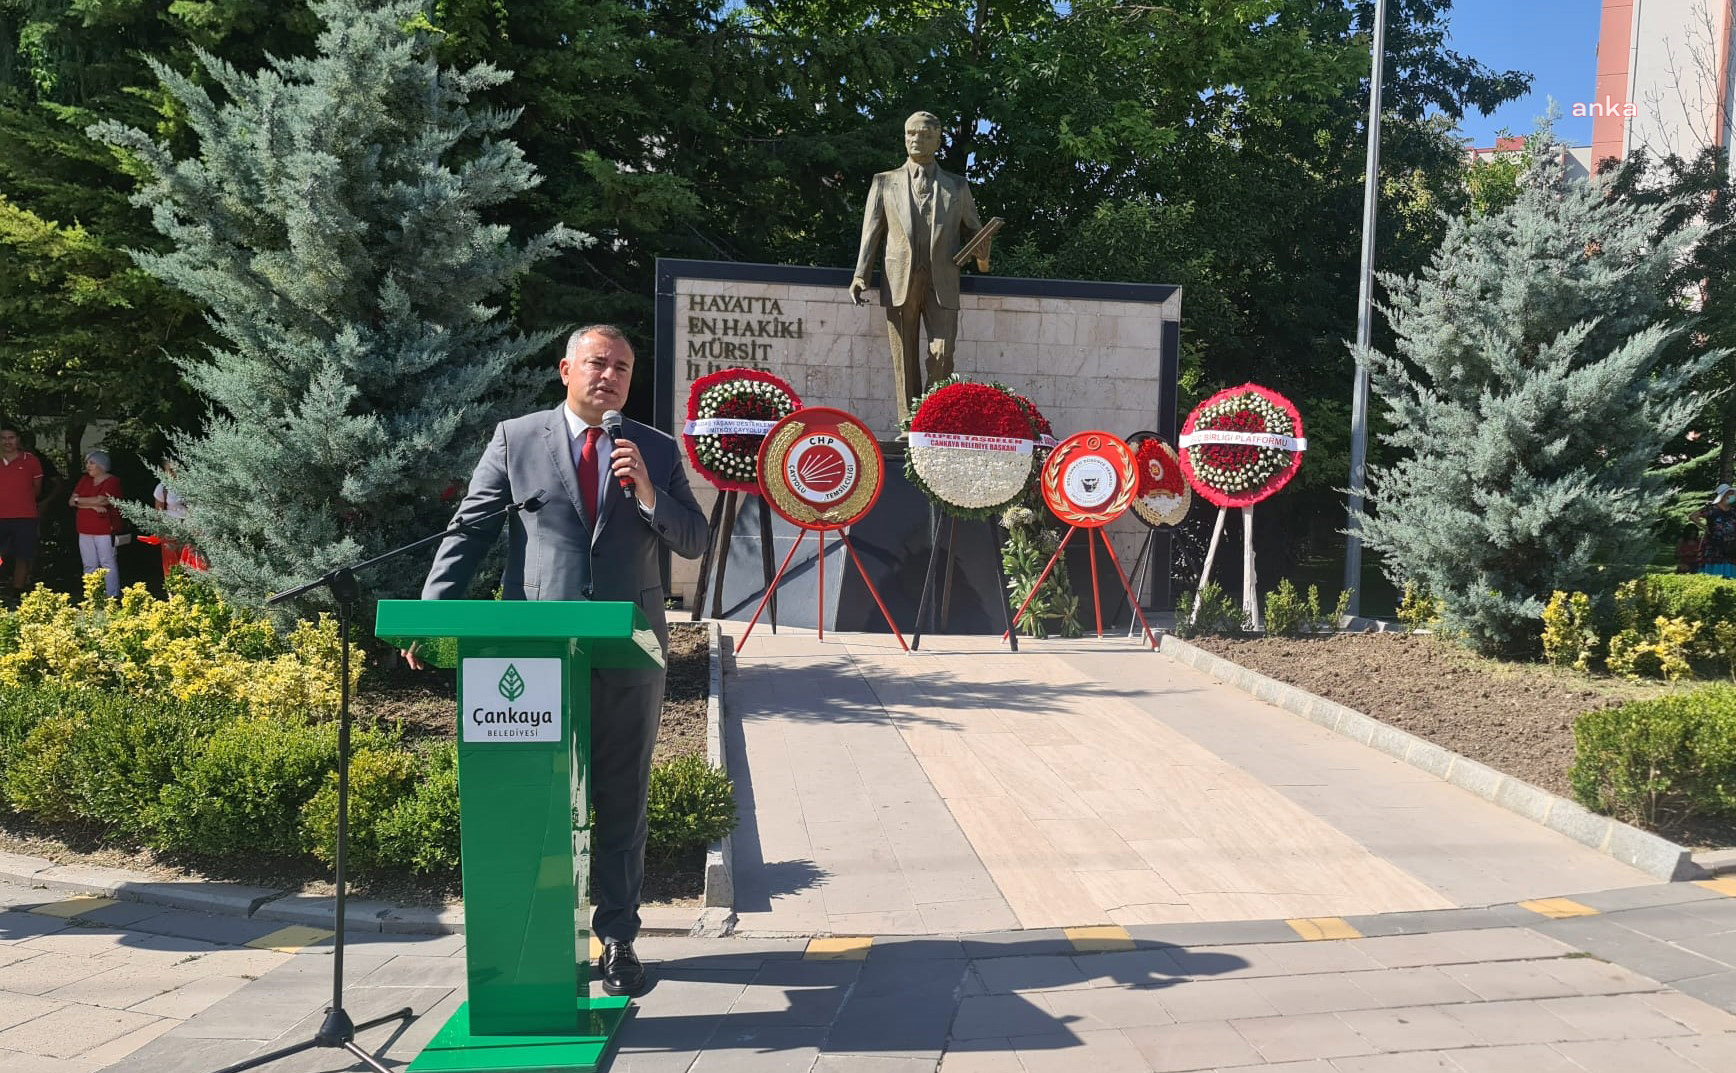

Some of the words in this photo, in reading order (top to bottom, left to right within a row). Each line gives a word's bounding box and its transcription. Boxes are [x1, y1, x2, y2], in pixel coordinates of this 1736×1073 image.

[688, 294, 784, 315] HAYATTA
[688, 316, 718, 335] EN
[722, 317, 803, 339] HAKİKİ
[809, 436, 834, 445] CHP
[1235, 434, 1288, 447] PLATFORMU
[472, 706, 552, 727] Çankaya
[487, 728, 538, 736] BELEDİYESİ
